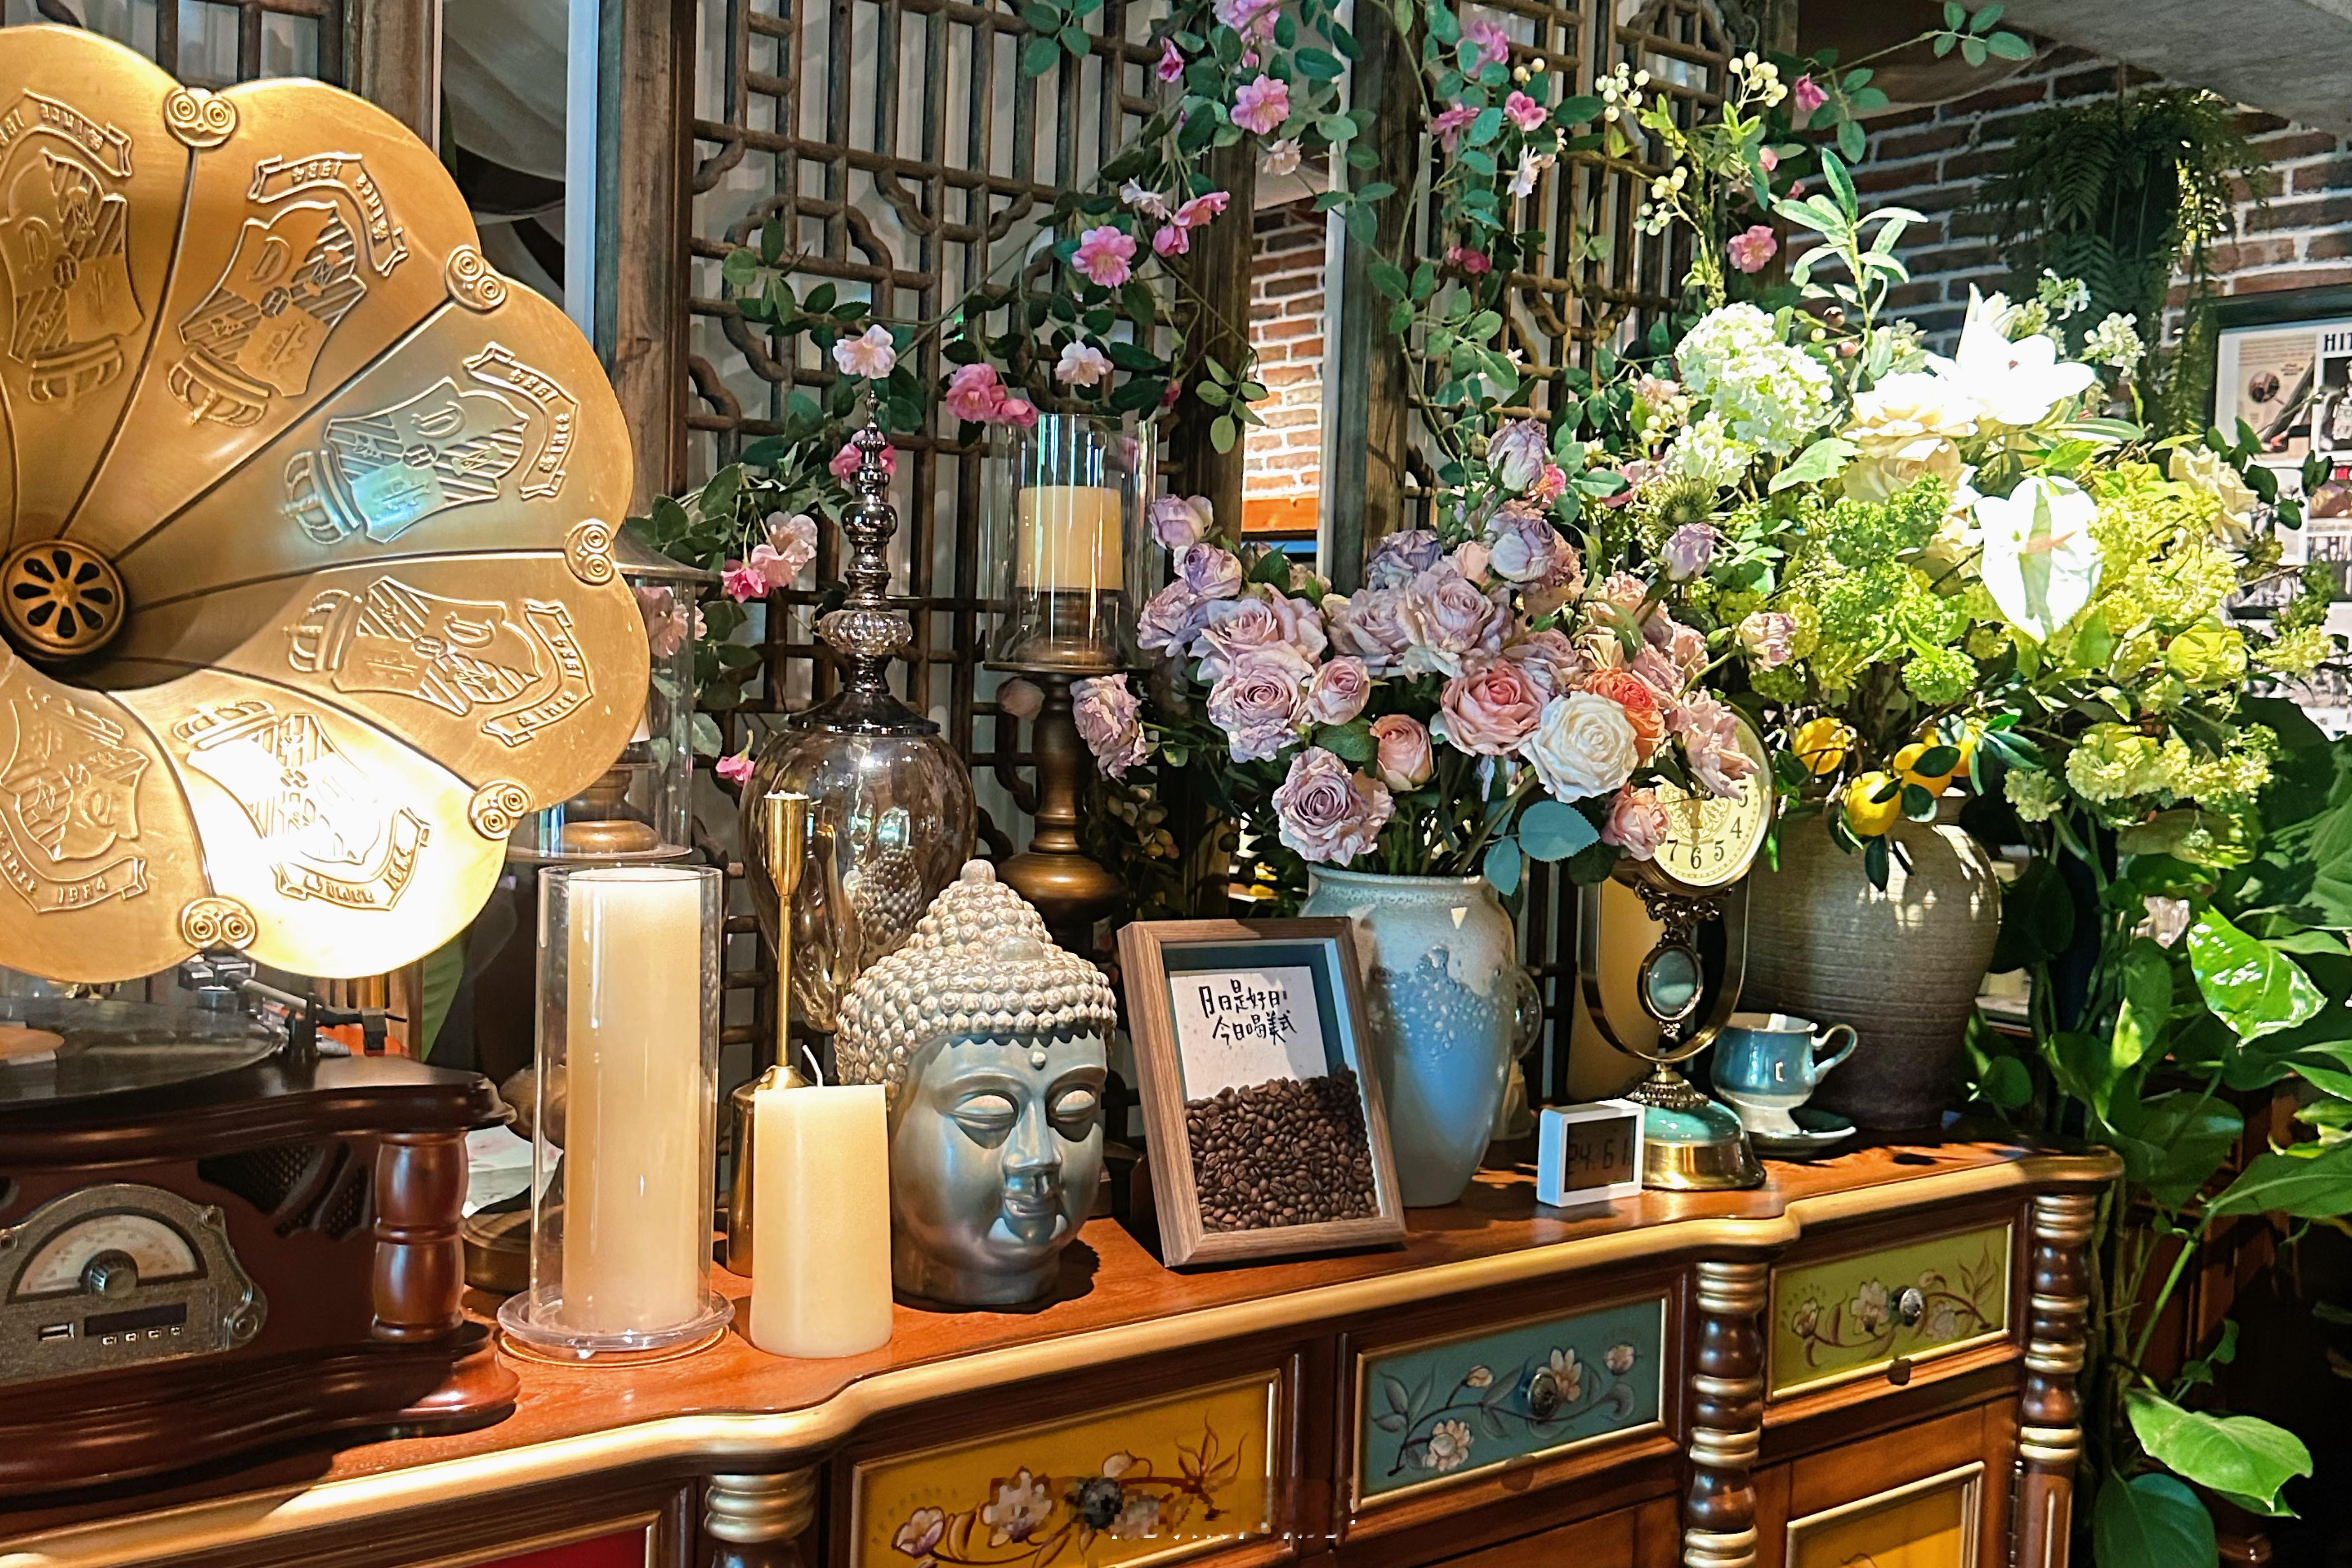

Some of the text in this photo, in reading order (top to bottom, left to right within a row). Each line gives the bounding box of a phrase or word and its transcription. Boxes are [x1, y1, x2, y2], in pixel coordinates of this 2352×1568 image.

[1737, 785, 1748, 808] 3
[1729, 817, 1743, 839] 4
[1666, 840, 1679, 862] 7
[1690, 847, 1701, 869] 6
[1714, 839, 1724, 862] 5
[1212, 1010, 1297, 1046] 今日喝美式
